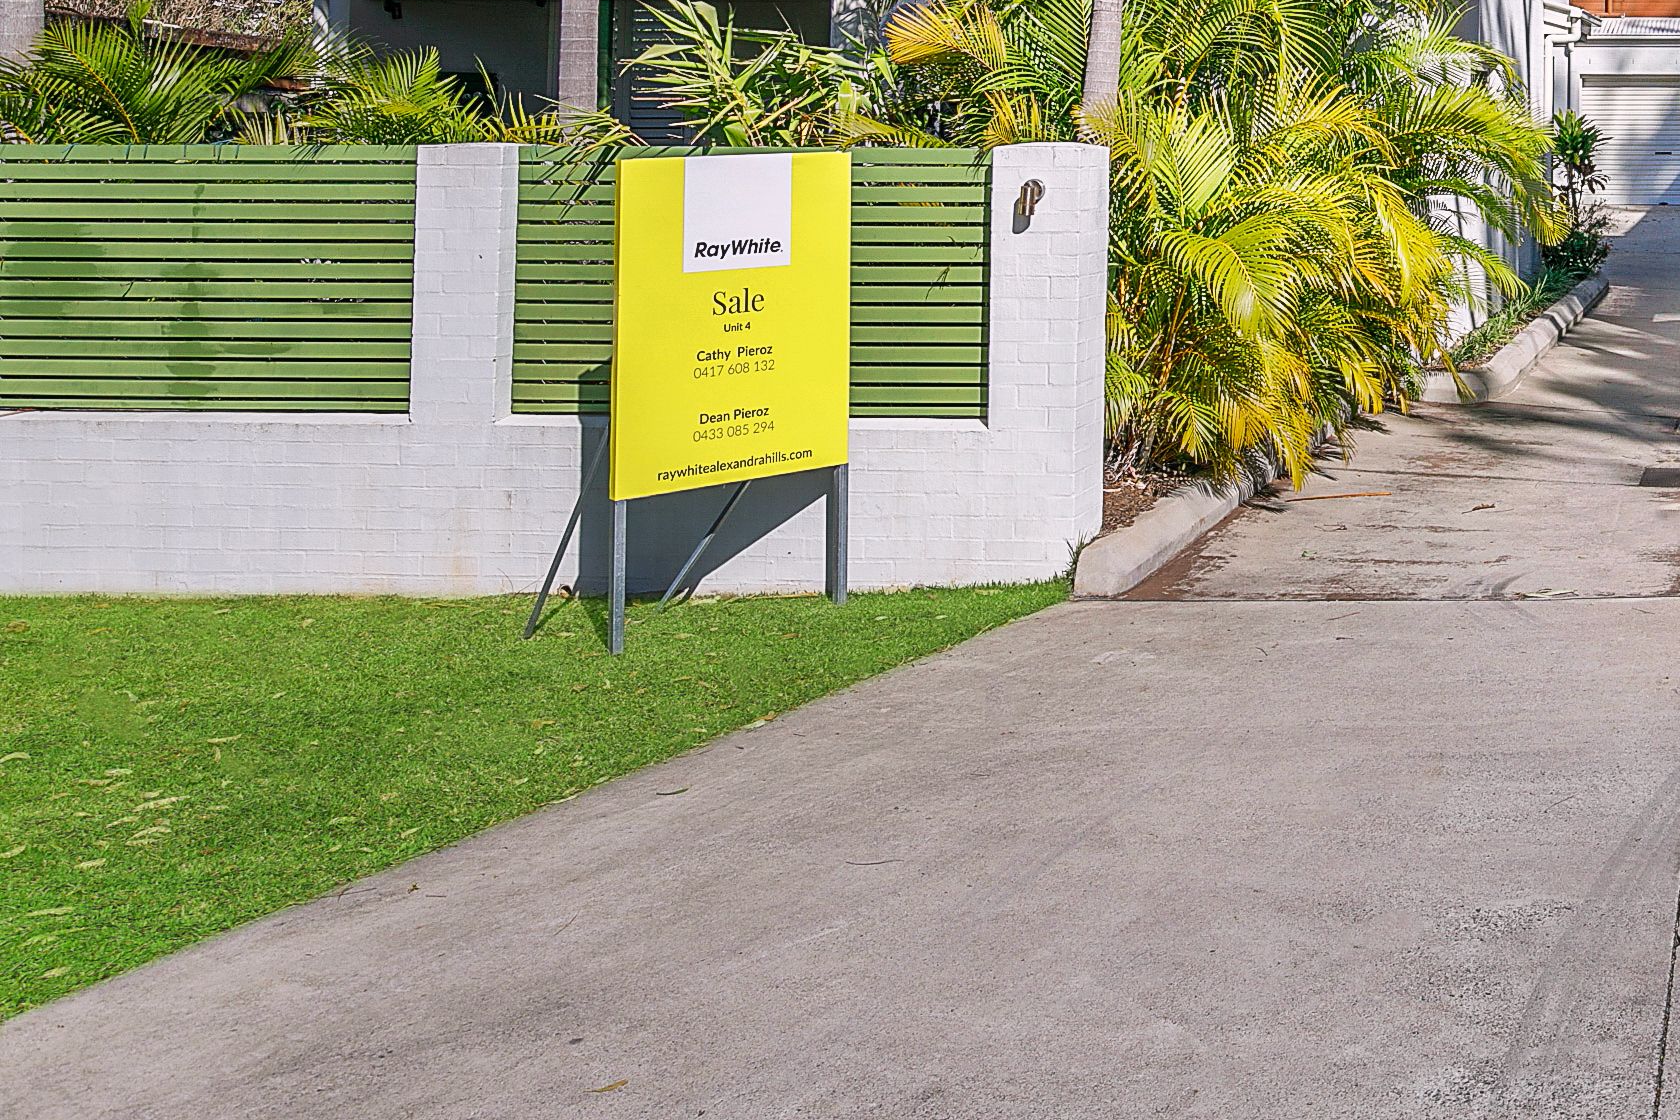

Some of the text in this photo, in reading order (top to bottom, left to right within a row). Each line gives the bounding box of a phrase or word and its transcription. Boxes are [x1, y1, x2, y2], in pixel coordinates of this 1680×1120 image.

[712, 287, 765, 316] Sale
[723, 321, 751, 333] Unit 4
[696, 345, 773, 362] Cathy Pieroz
[693, 358, 775, 380] 0417 608 132
[699, 406, 770, 425] Dean Pieroz
[692, 420, 775, 443] 0433 085 294
[657, 448, 813, 482] raywhitealexandrahills.com
